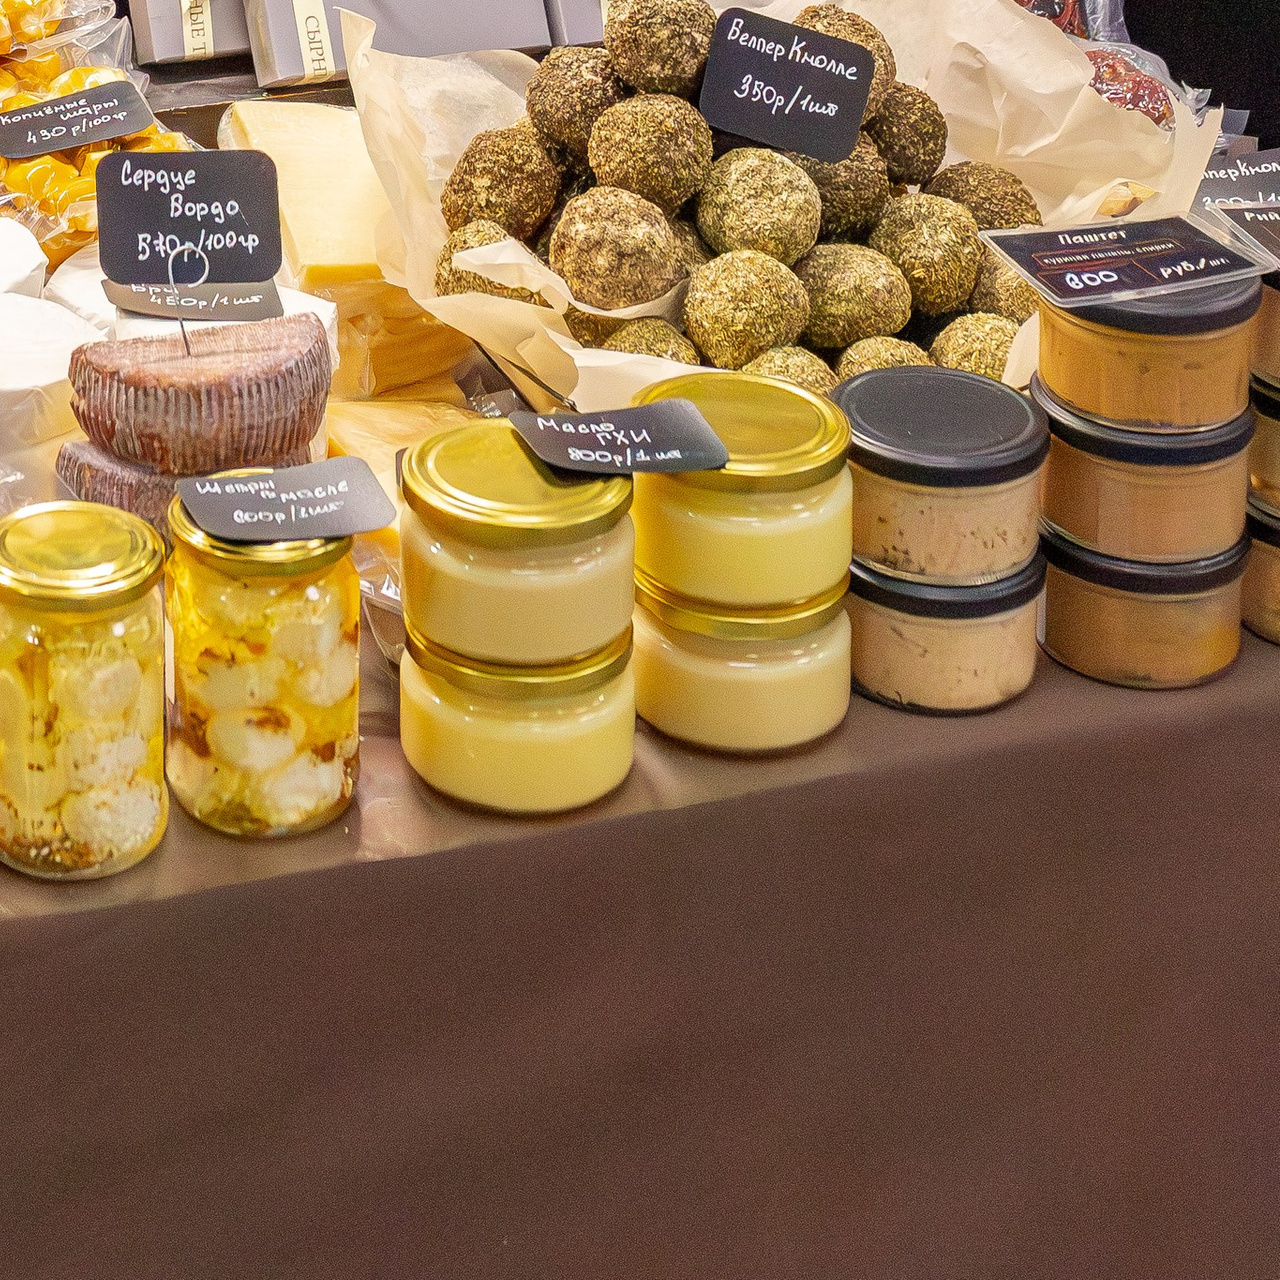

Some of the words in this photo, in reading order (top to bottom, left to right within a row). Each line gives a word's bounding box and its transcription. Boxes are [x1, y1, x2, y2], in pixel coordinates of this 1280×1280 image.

[0, 98, 88, 126] Копчёные
[60, 99, 119, 122] шары
[121, 159, 196, 194] Сердце
[536, 416, 615, 432] Масло
